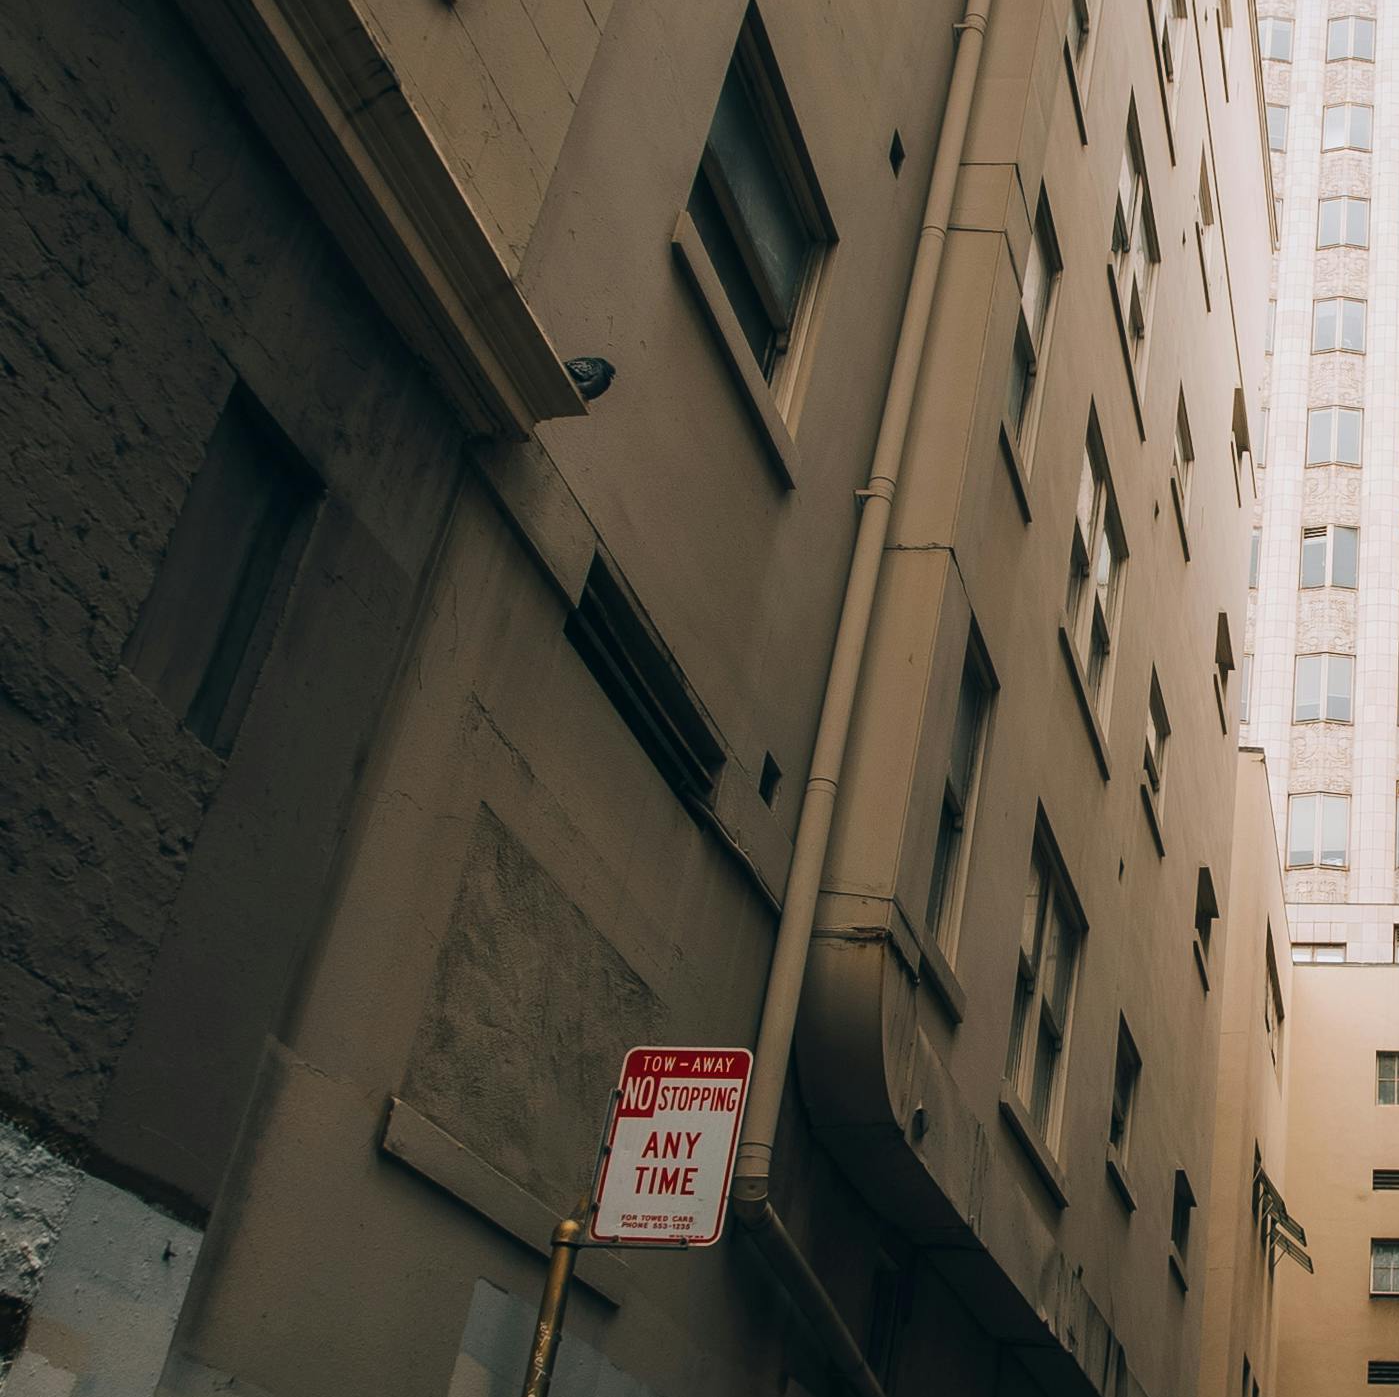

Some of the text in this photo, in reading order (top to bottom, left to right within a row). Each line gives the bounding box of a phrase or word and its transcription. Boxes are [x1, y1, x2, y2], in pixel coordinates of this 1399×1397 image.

[622, 1076, 738, 1112] NO STOPPING
[641, 1131, 702, 1159] ANY
[635, 1166, 698, 1196] TIME
[641, 1214, 669, 1222] TOWED
[672, 1215, 694, 1223] CARS
